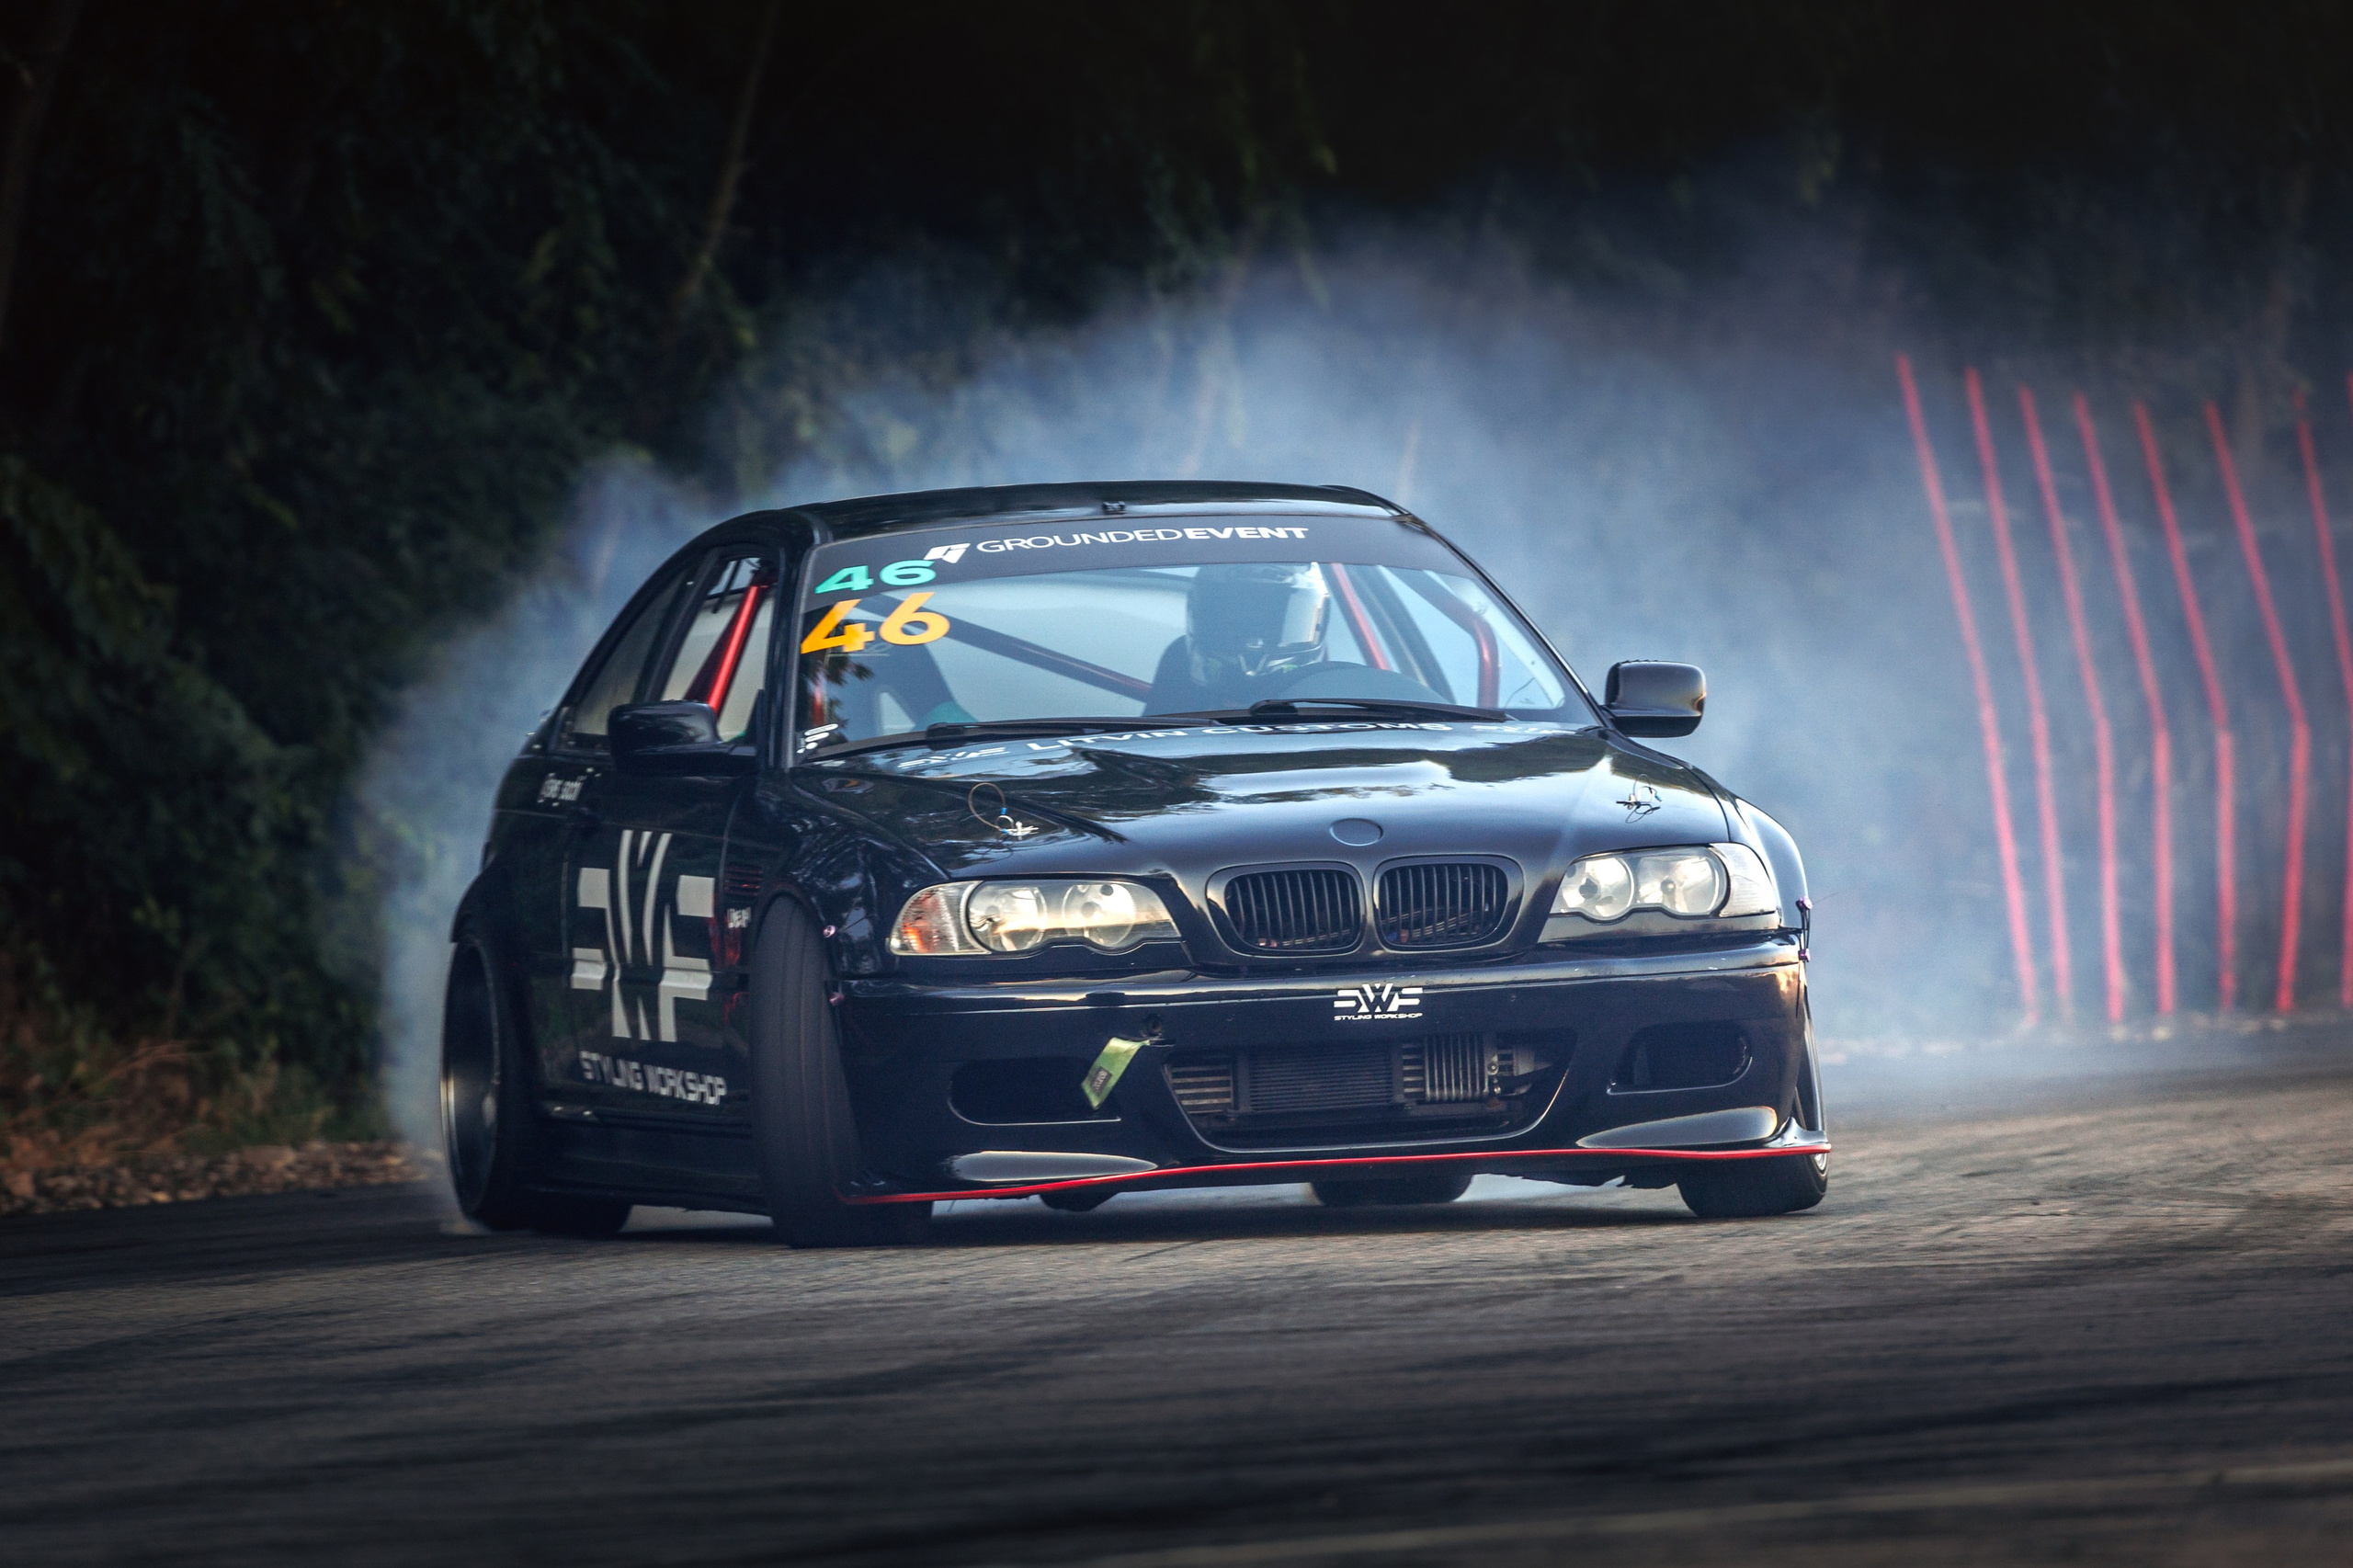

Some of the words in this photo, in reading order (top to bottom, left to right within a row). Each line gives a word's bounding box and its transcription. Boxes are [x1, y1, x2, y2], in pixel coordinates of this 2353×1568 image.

[977, 527, 1309, 553] GROUNDEDEVENT
[814, 559, 937, 594] 46
[801, 591, 951, 654] 46
[1026, 730, 1188, 751] LITVIN
[1201, 722, 1453, 734] CUSTOMS
[1373, 1012, 1423, 1020] WORKSHOP
[579, 1050, 644, 1091] STYLING
[643, 1063, 728, 1106] WORKSHOP
